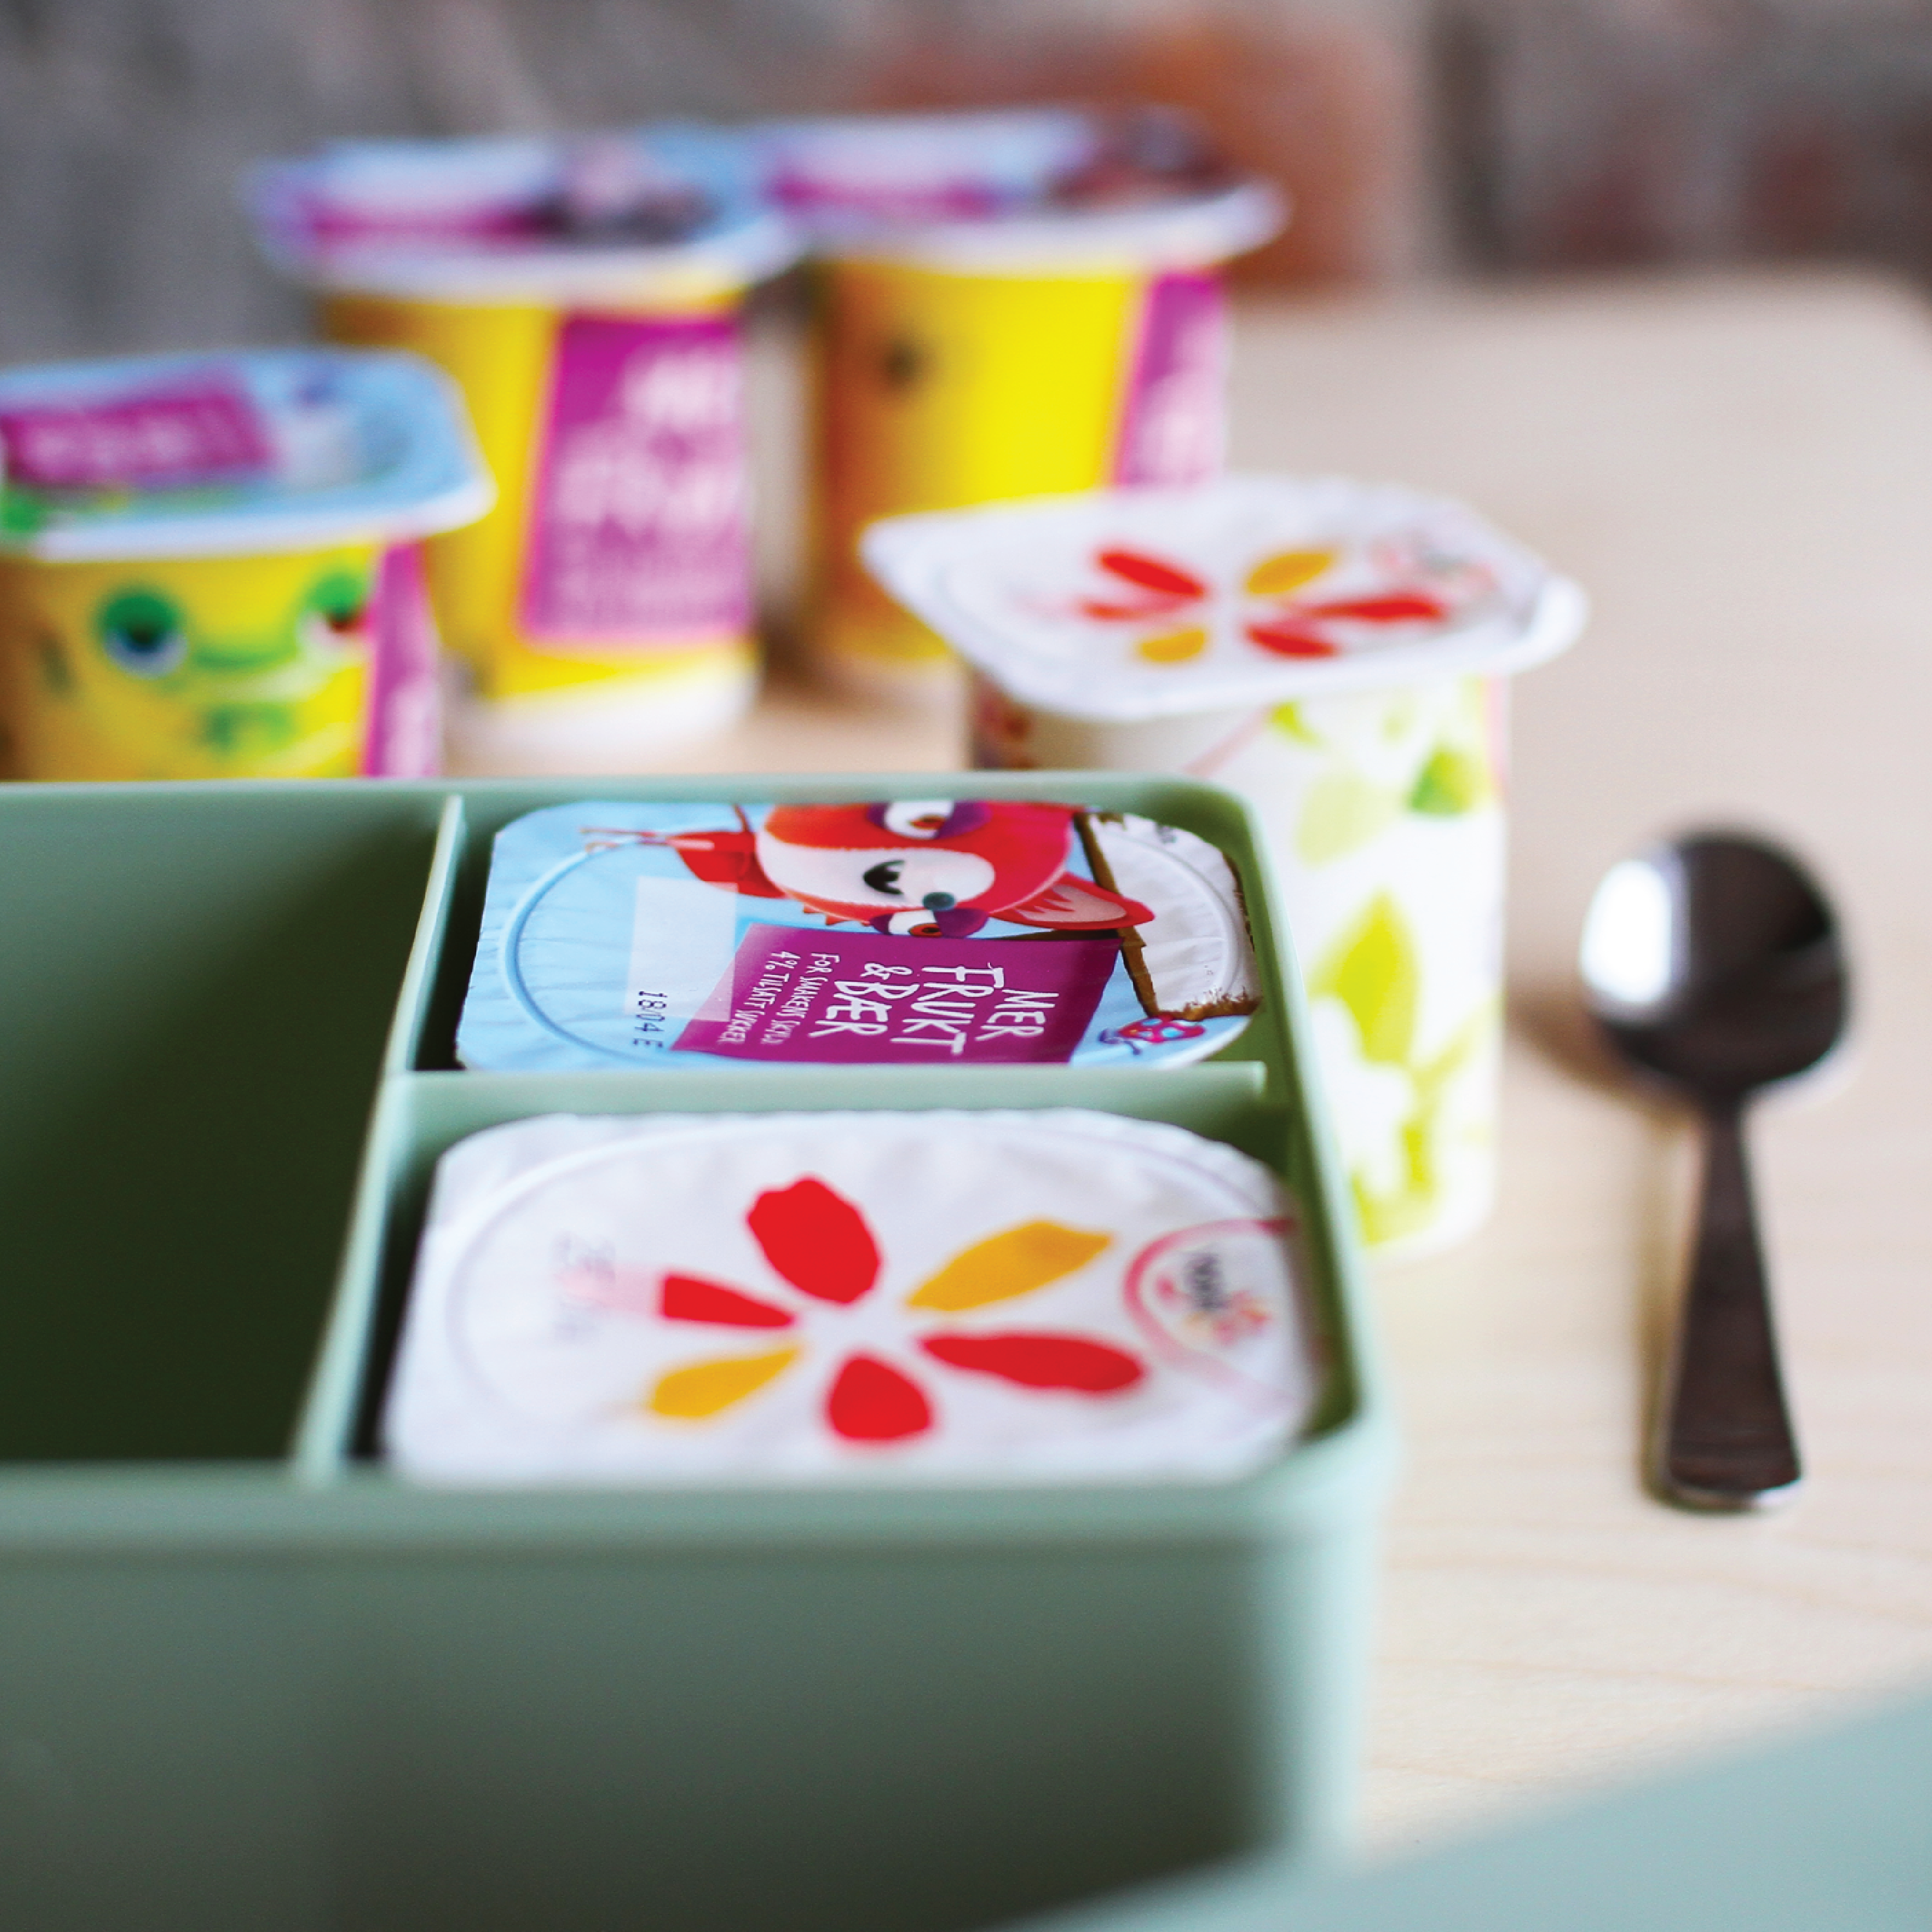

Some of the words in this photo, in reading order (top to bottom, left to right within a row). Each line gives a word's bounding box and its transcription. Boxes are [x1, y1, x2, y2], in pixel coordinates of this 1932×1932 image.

[764, 951, 800, 970] 4%
[805, 953, 840, 973] FOR
[860, 961, 913, 980] &
[743, 973, 790, 1009] TILSATT
[775, 976, 828, 1018] SMAKENS
[893, 963, 1004, 1054] FRUKT
[634, 991, 667, 1032] 18/04
[716, 1009, 765, 1044] SUKKER
[808, 981, 920, 1038] BÆR
[975, 989, 1059, 1041] MER
[633, 1038, 663, 1048] E
